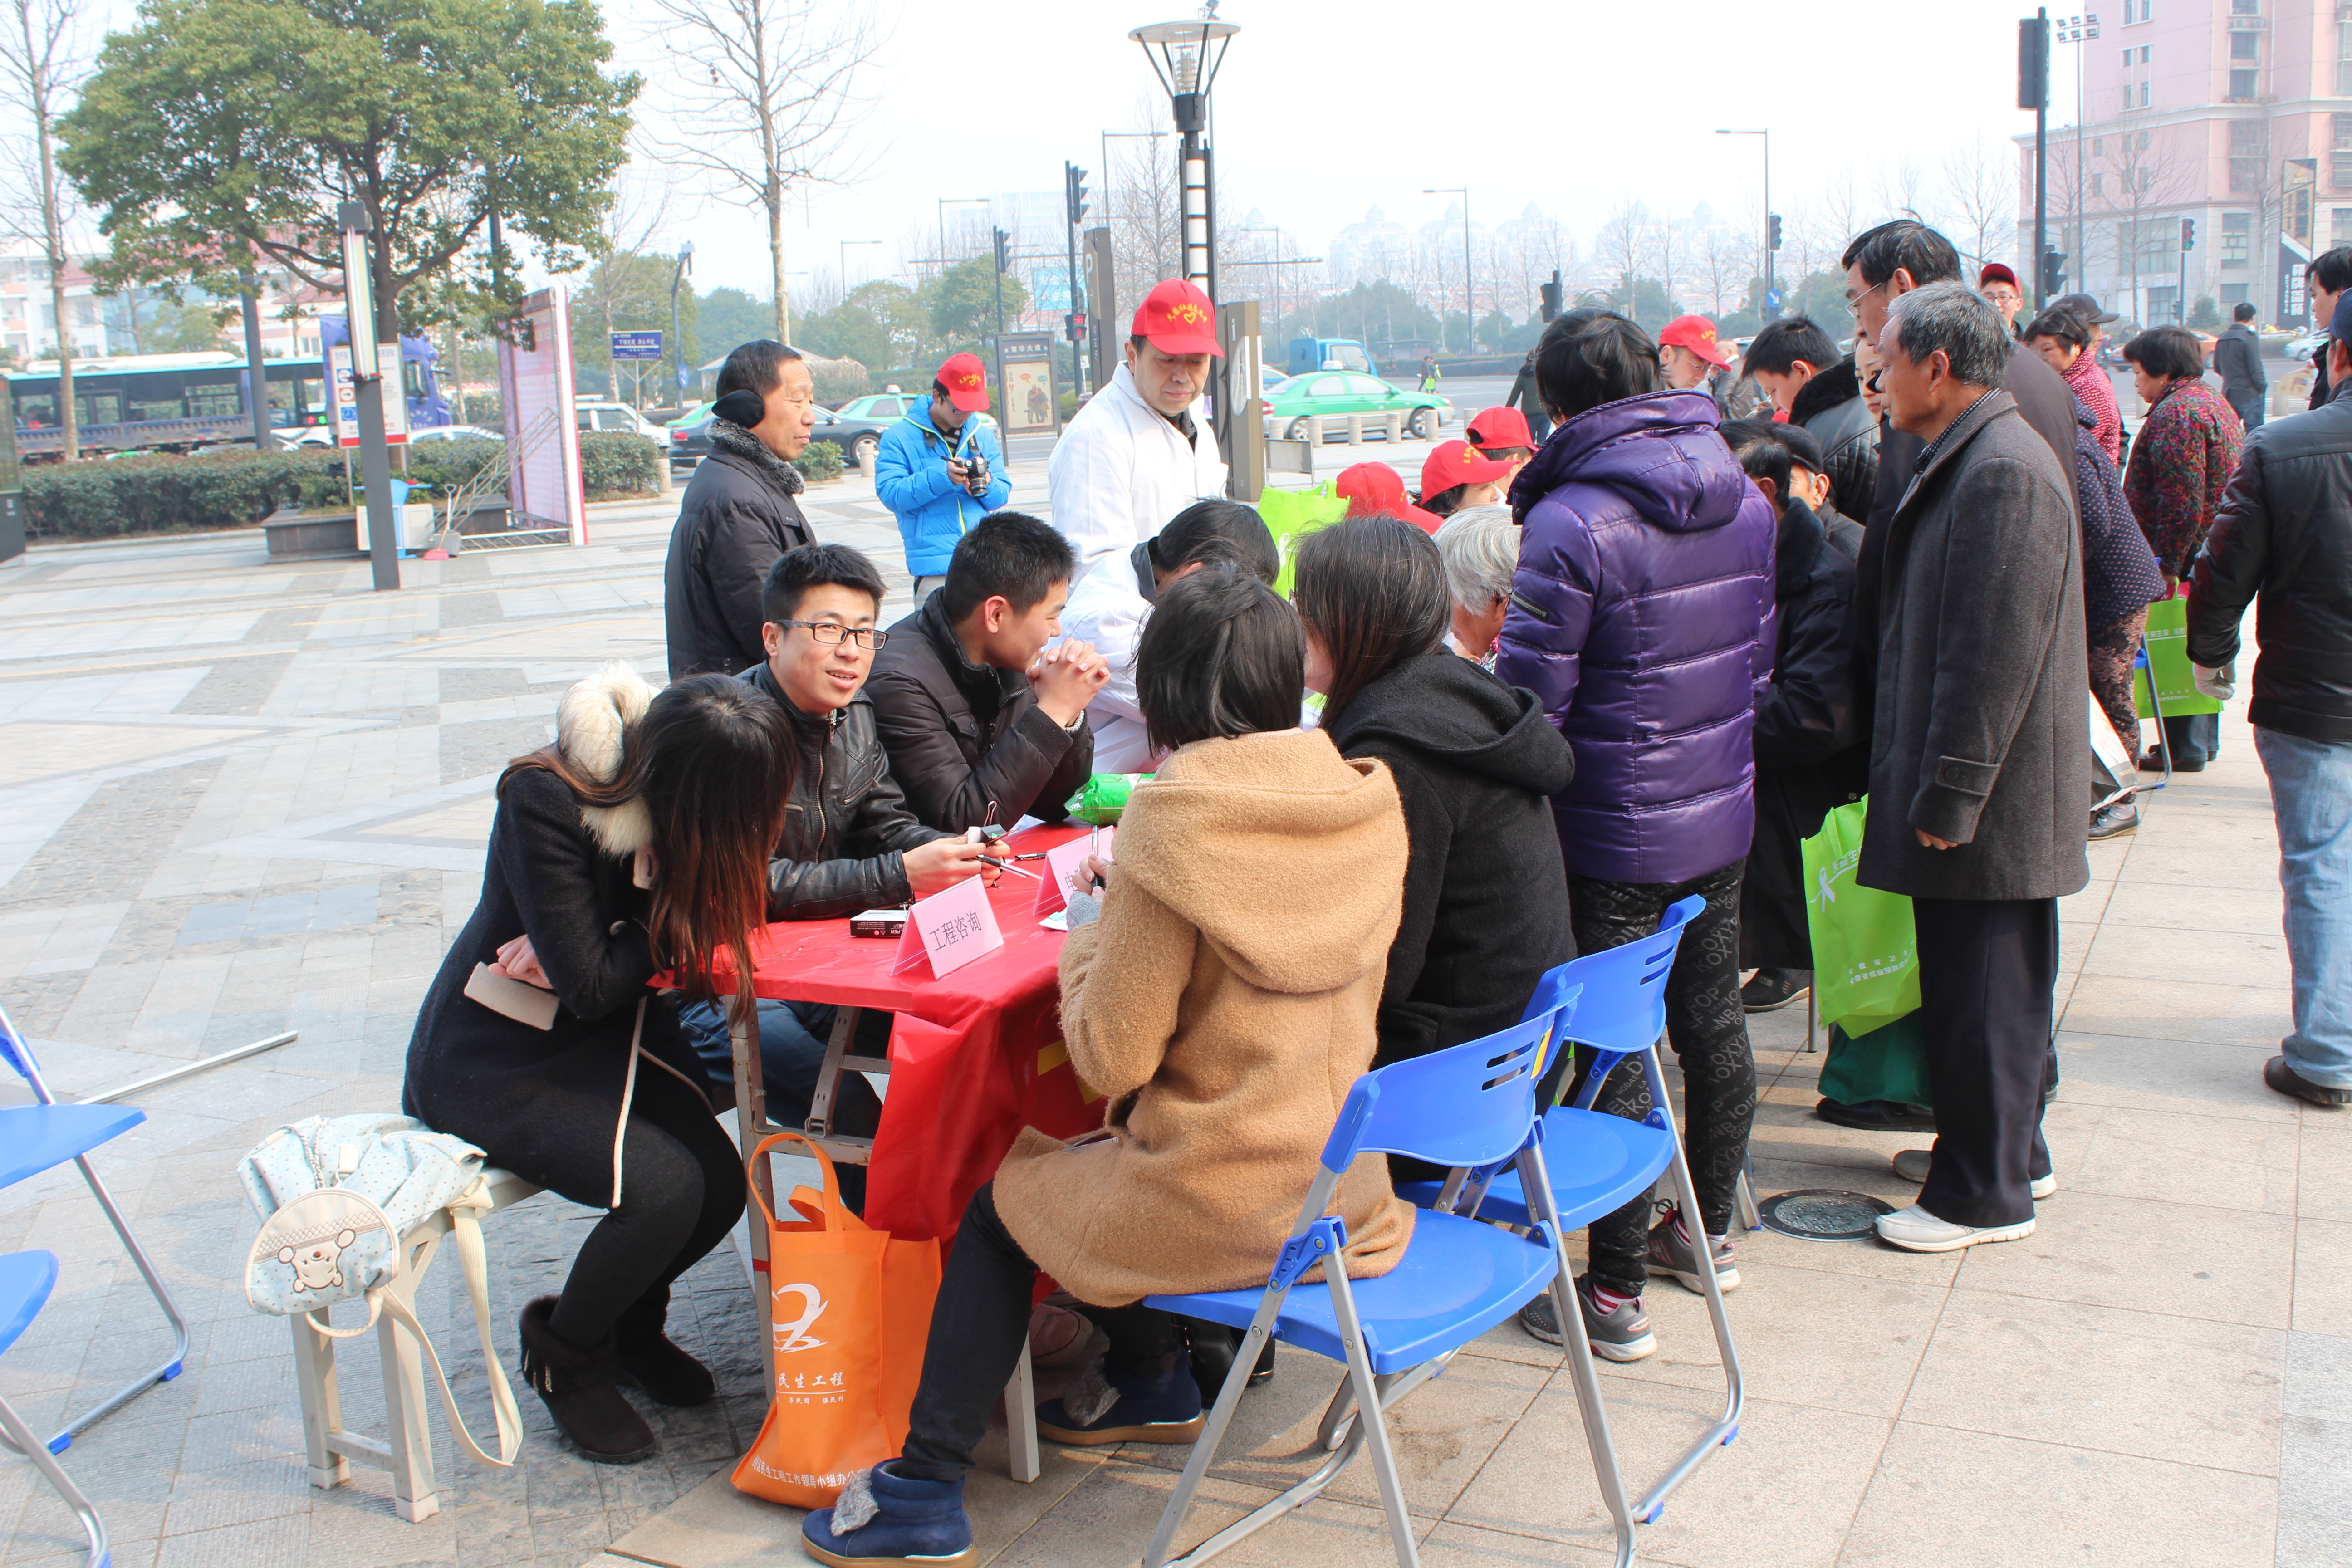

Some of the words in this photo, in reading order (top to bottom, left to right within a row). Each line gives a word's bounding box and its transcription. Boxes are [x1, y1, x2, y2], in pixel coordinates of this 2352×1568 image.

[1085, 253, 1093, 284] P
[1011, 344, 1041, 353] 繁华大道
[1064, 869, 1082, 892] 电
[929, 910, 981, 952] 工程咨询
[779, 1372, 844, 1389] 民生工程
[822, 1395, 844, 1405] 保民利
